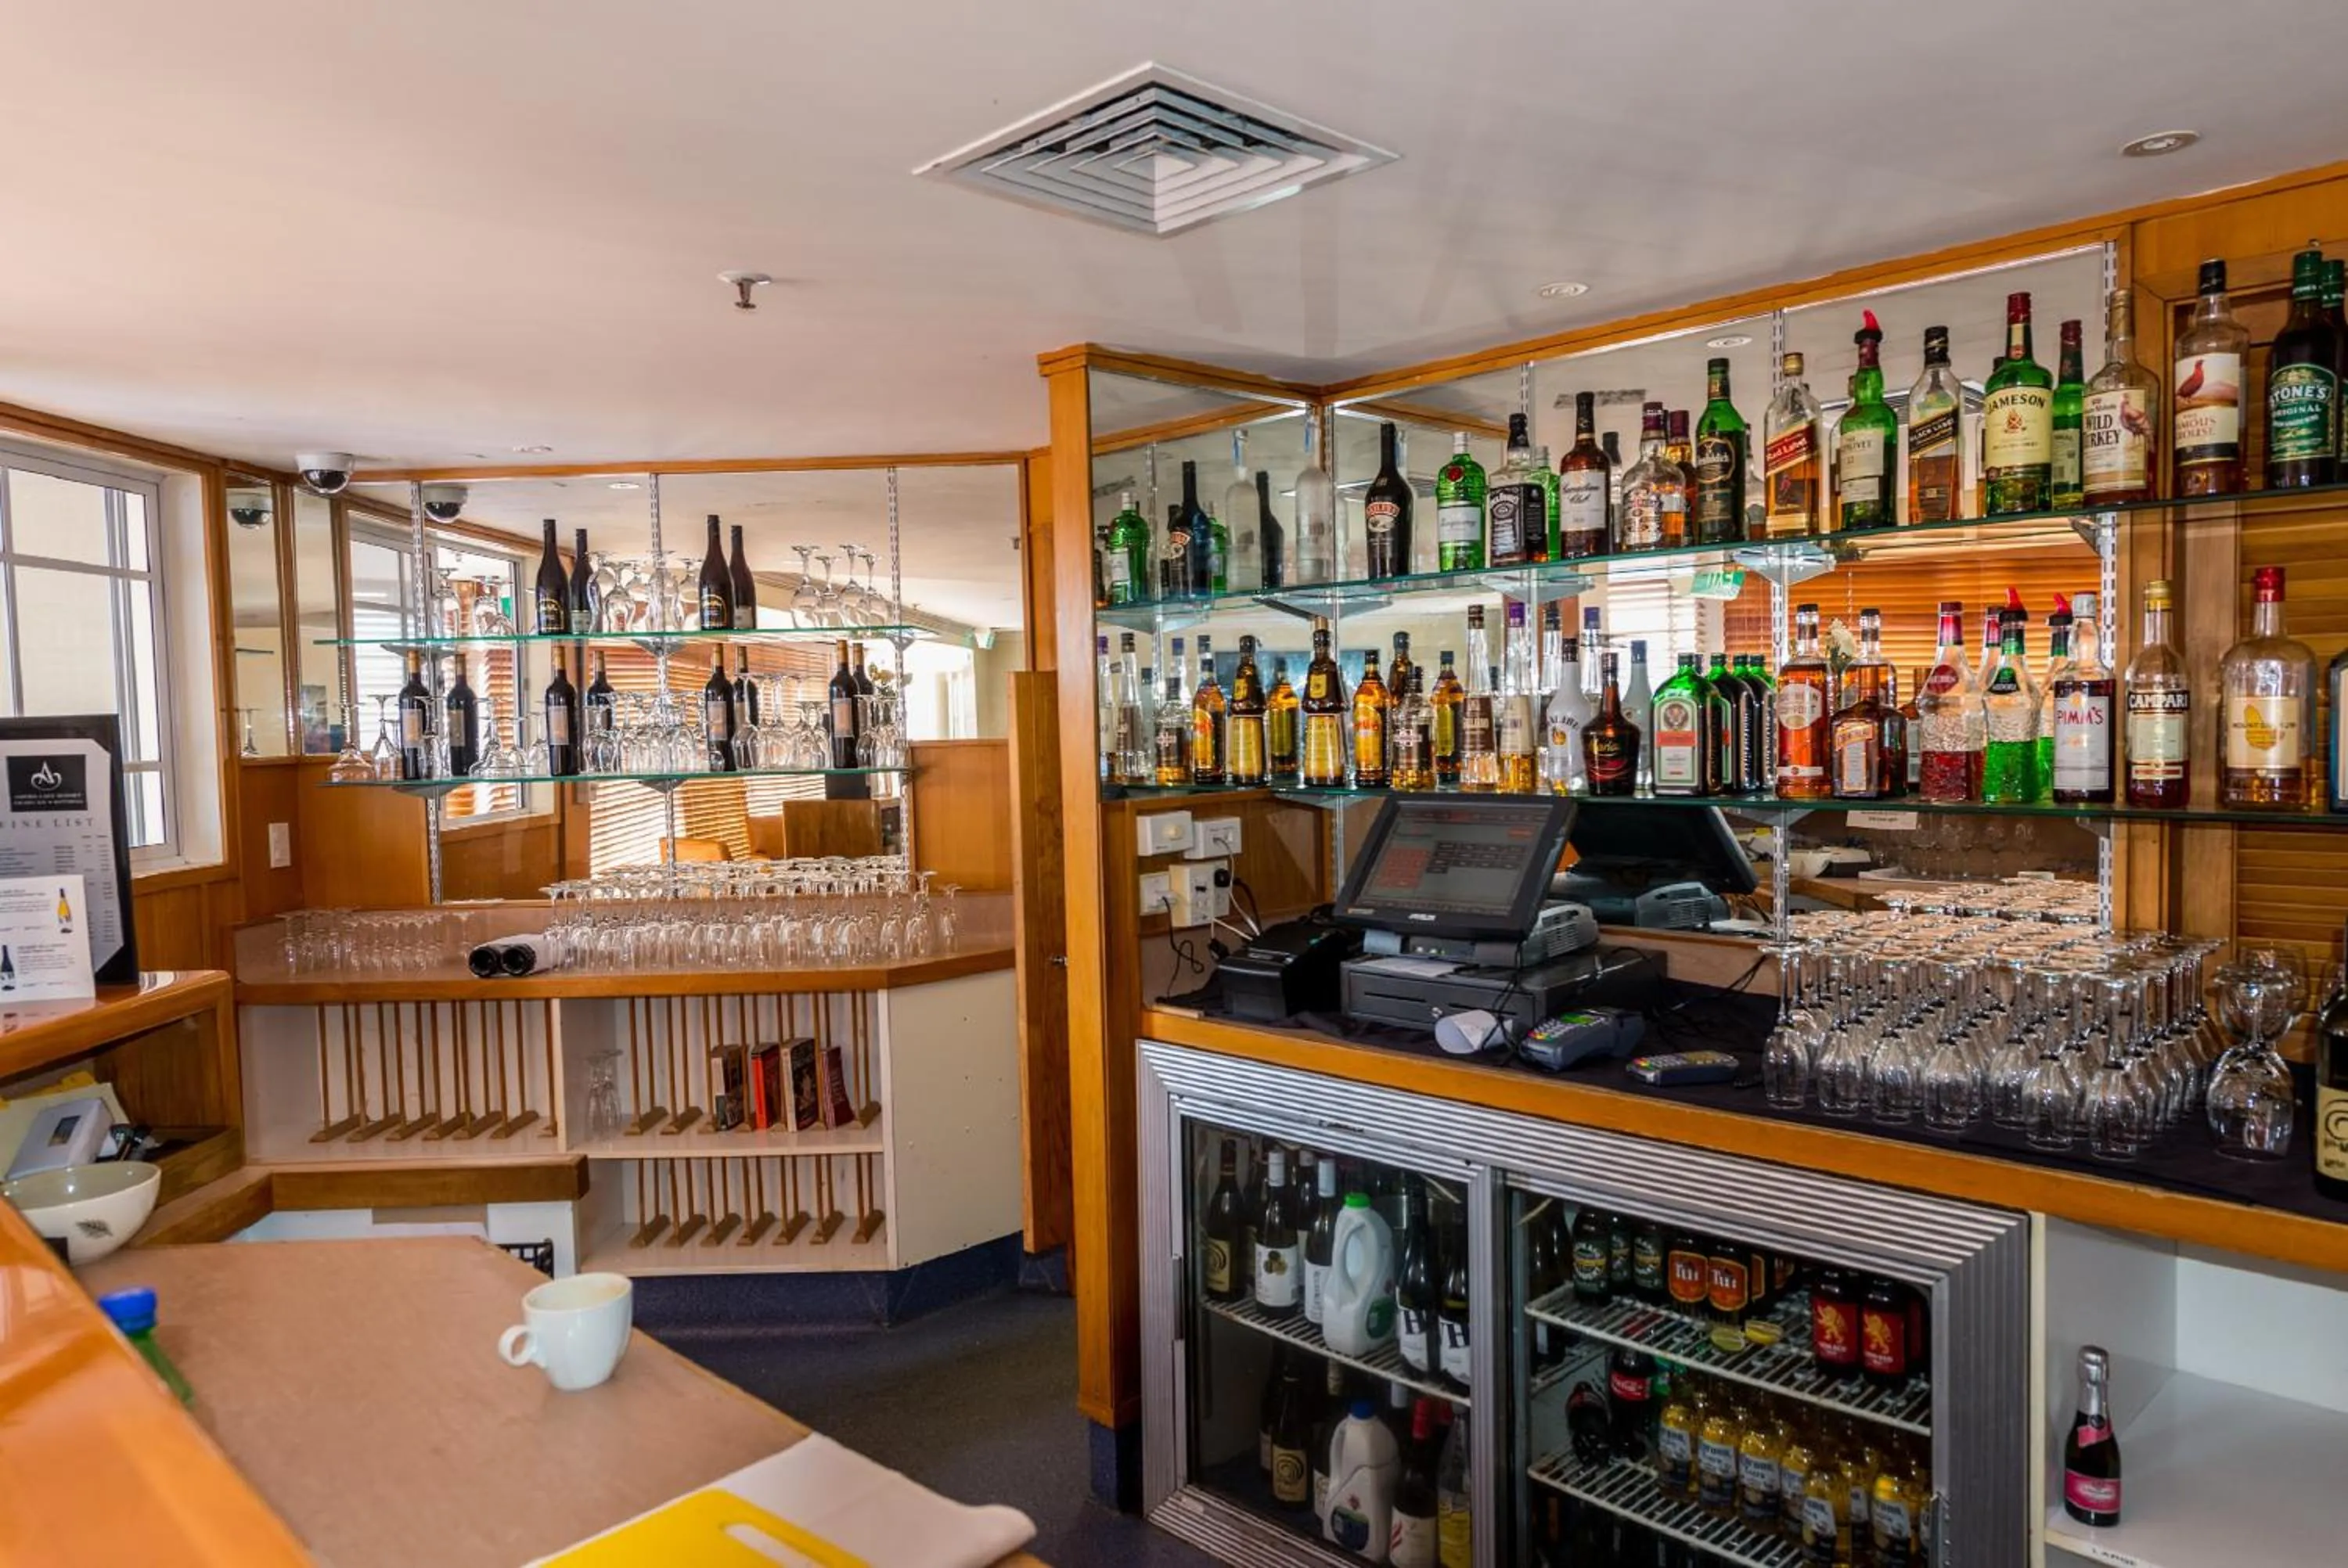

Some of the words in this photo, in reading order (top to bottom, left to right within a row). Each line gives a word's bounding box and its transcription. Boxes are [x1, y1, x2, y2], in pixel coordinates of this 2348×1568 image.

[1988, 394, 2046, 414] JAMESON
[2086, 414, 2112, 430] WILD
[1766, 447, 1783, 462] Red
[1782, 437, 1807, 454] Label
[2129, 693, 2188, 709] CAMPARI
[2056, 706, 2104, 725] PIMM'S
[53, 818, 93, 827] LIST
